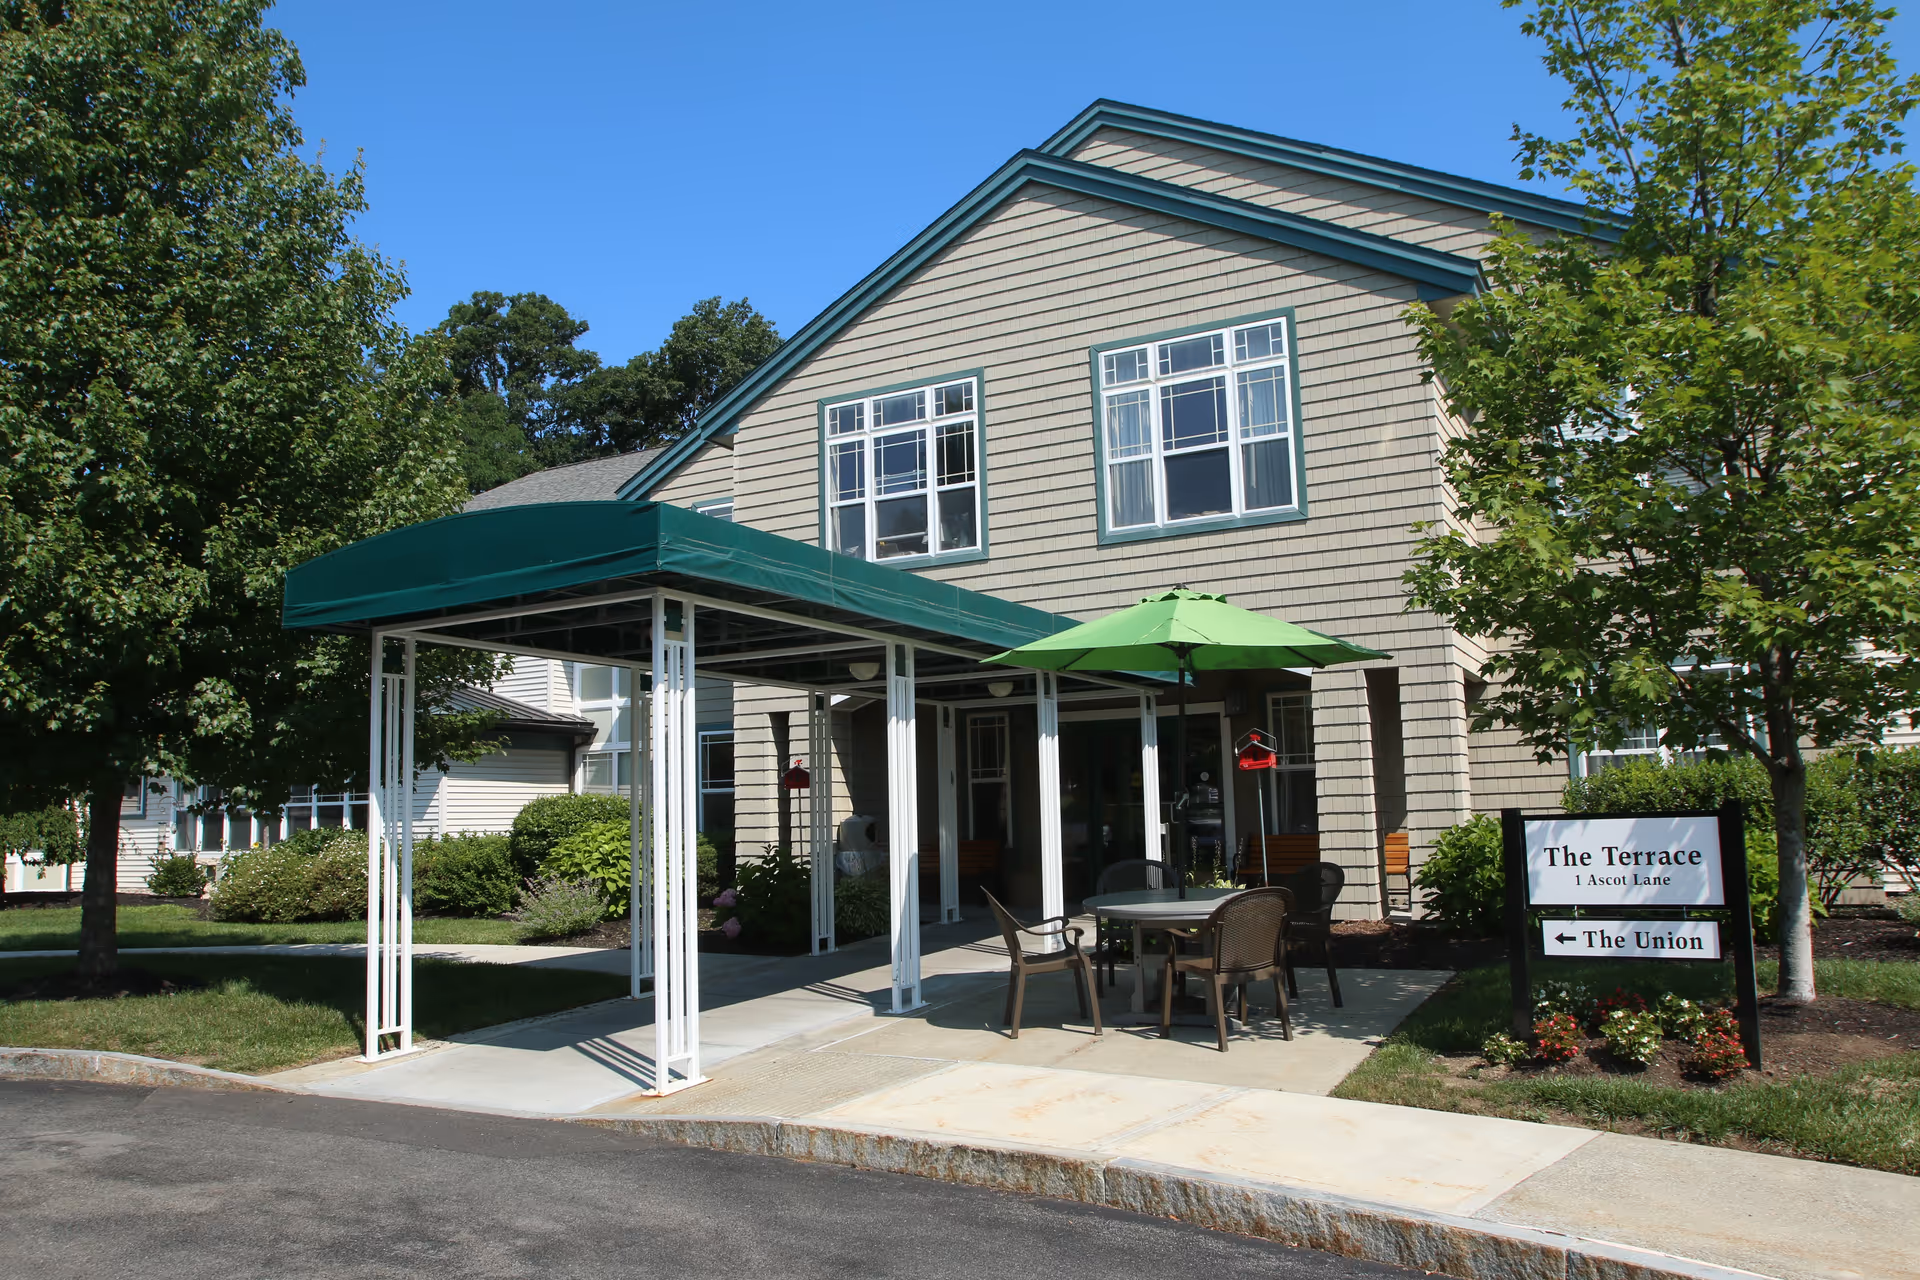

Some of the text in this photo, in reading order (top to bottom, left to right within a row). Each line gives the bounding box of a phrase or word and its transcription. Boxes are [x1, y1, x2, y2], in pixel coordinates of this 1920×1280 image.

[1544, 845, 1702, 867] The Terrace
[1575, 874, 1671, 886] 1 Ascot Lane
[1583, 930, 1704, 950] The Union
